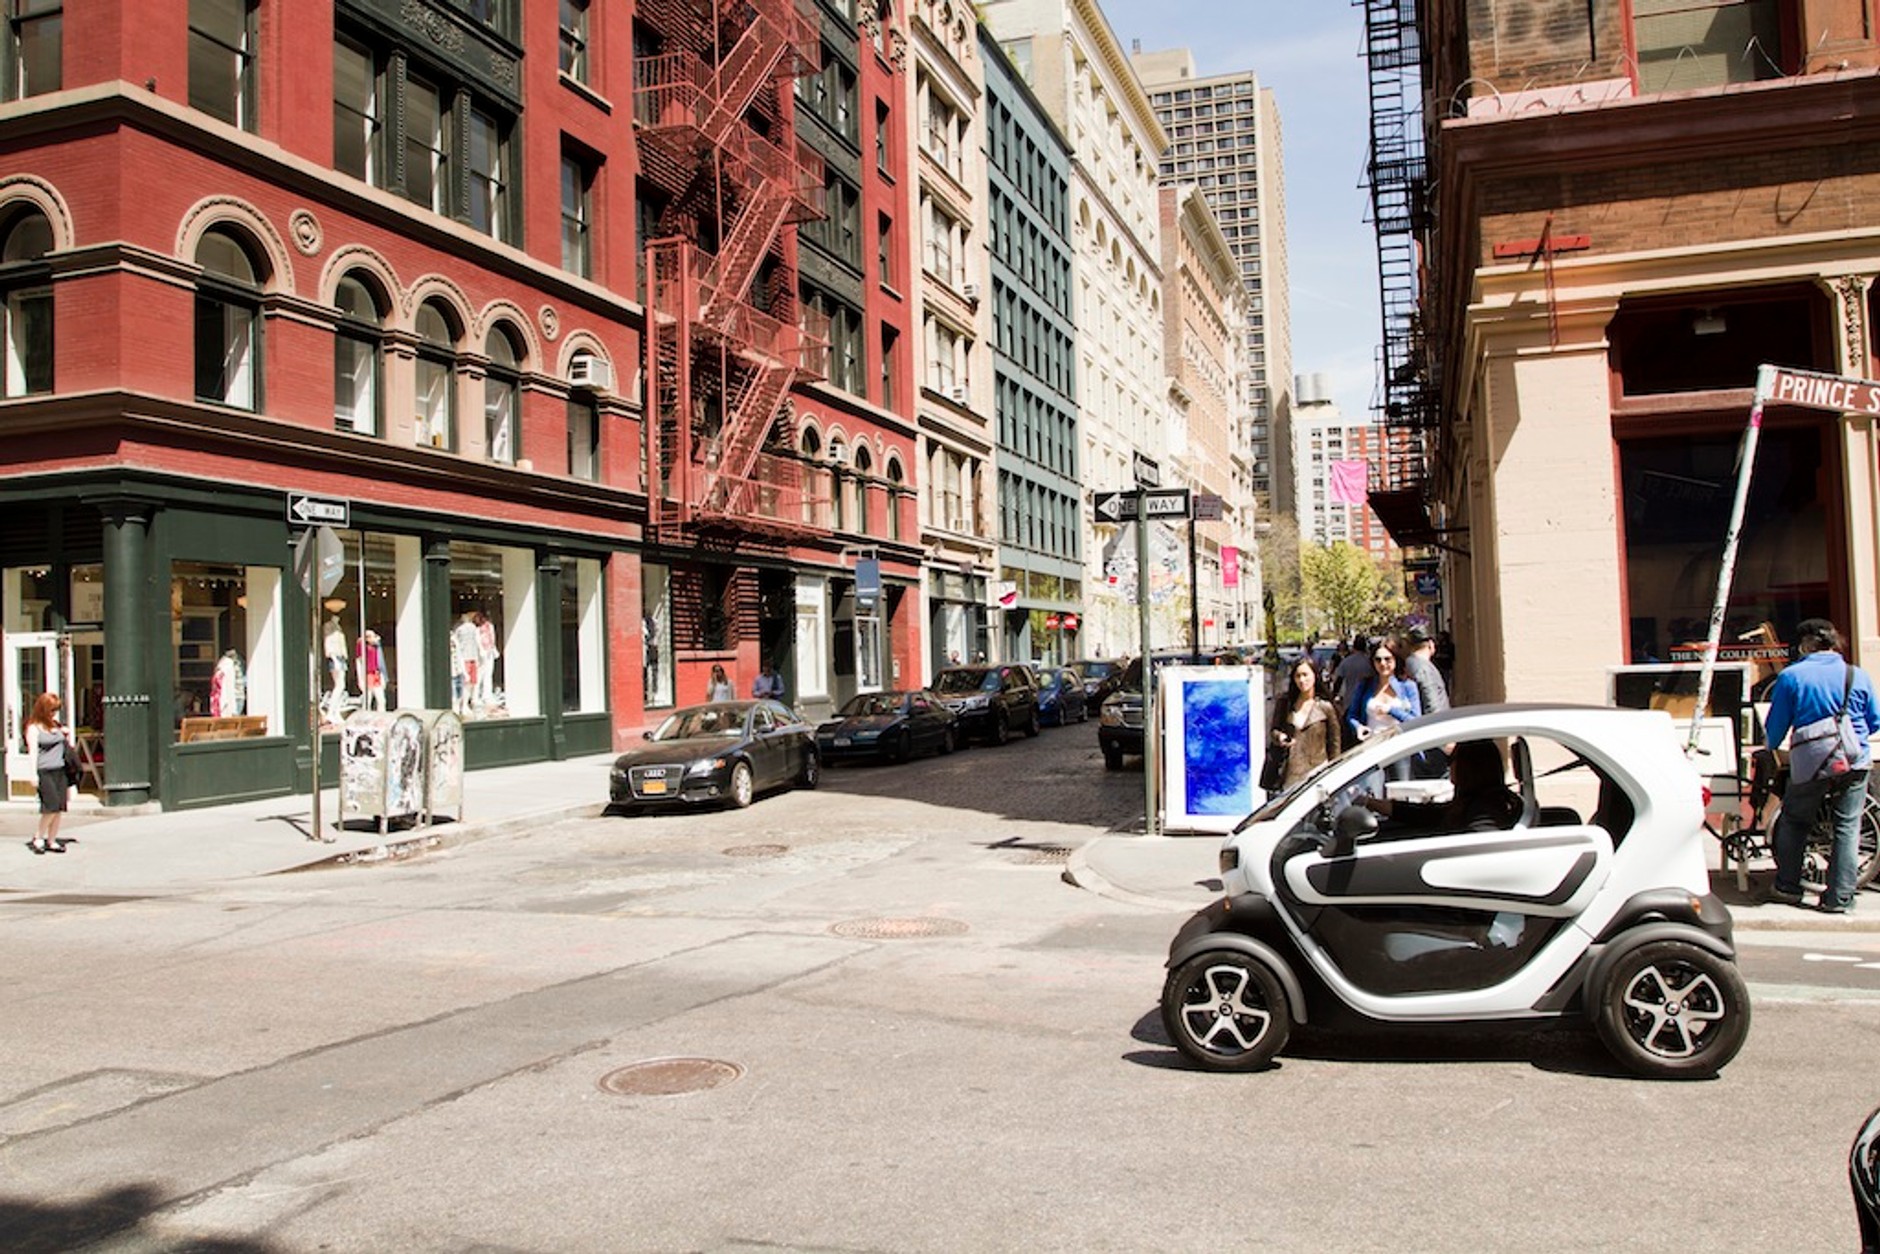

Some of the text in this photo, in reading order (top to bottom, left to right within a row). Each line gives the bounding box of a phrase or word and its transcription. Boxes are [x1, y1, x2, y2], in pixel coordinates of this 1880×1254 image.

[1779, 374, 1858, 409] PRINCE
[299, 502, 342, 517] ONE WAY
[1108, 498, 1178, 514] ONE WAY
[1670, 651, 1693, 661] THE
[1720, 648, 1789, 659] COLLECTION
